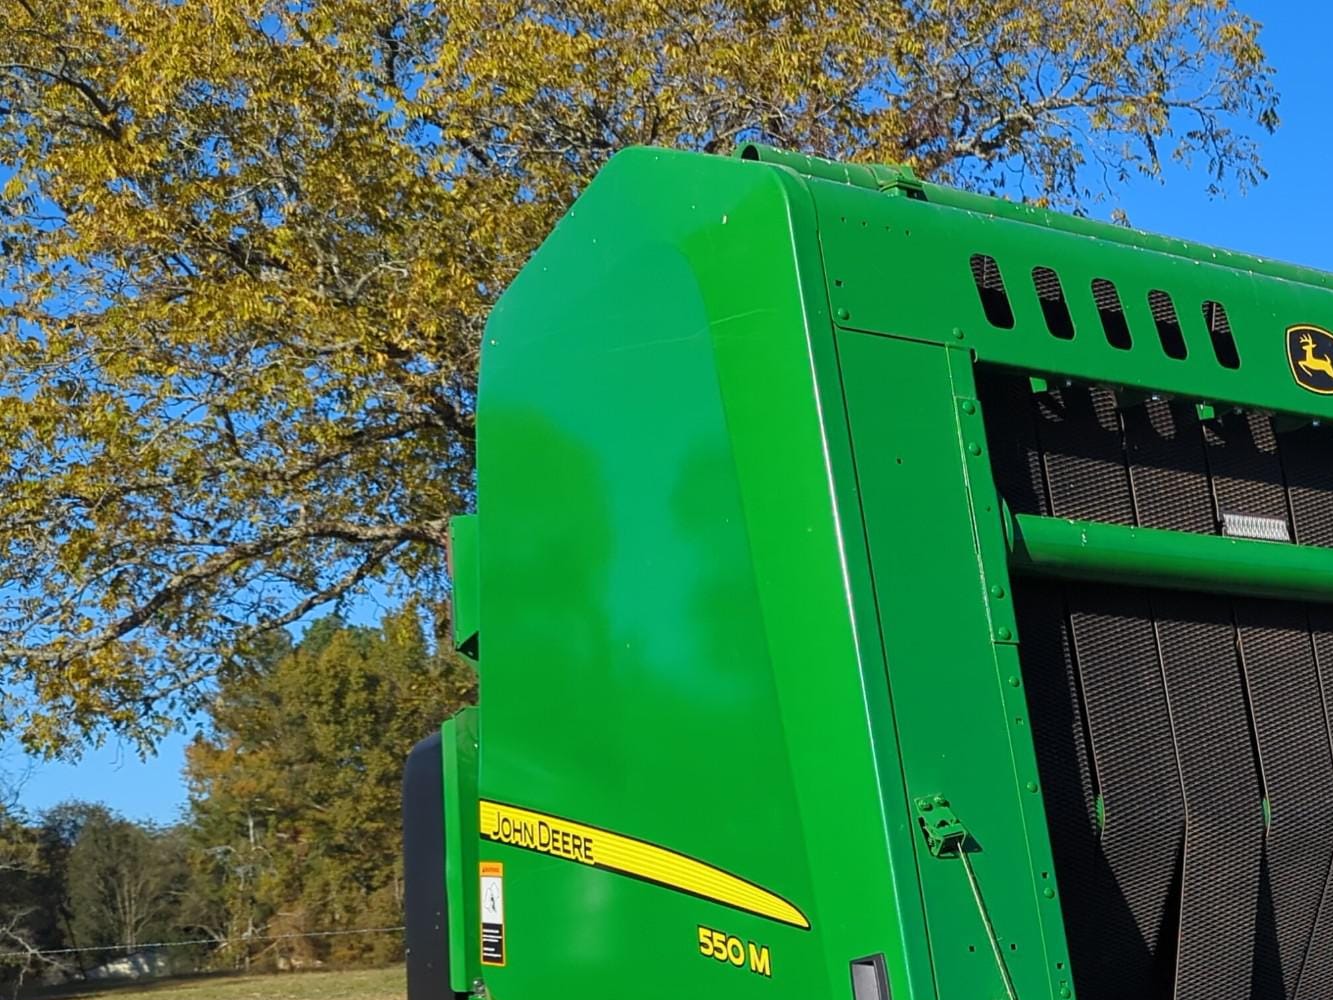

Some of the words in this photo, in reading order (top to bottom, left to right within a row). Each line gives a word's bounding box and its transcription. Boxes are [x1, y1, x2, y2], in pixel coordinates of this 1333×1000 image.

[493, 811, 535, 845] JOHN
[538, 821, 594, 860] DEERE
[698, 925, 746, 968] 550
[748, 941, 771, 977] M
